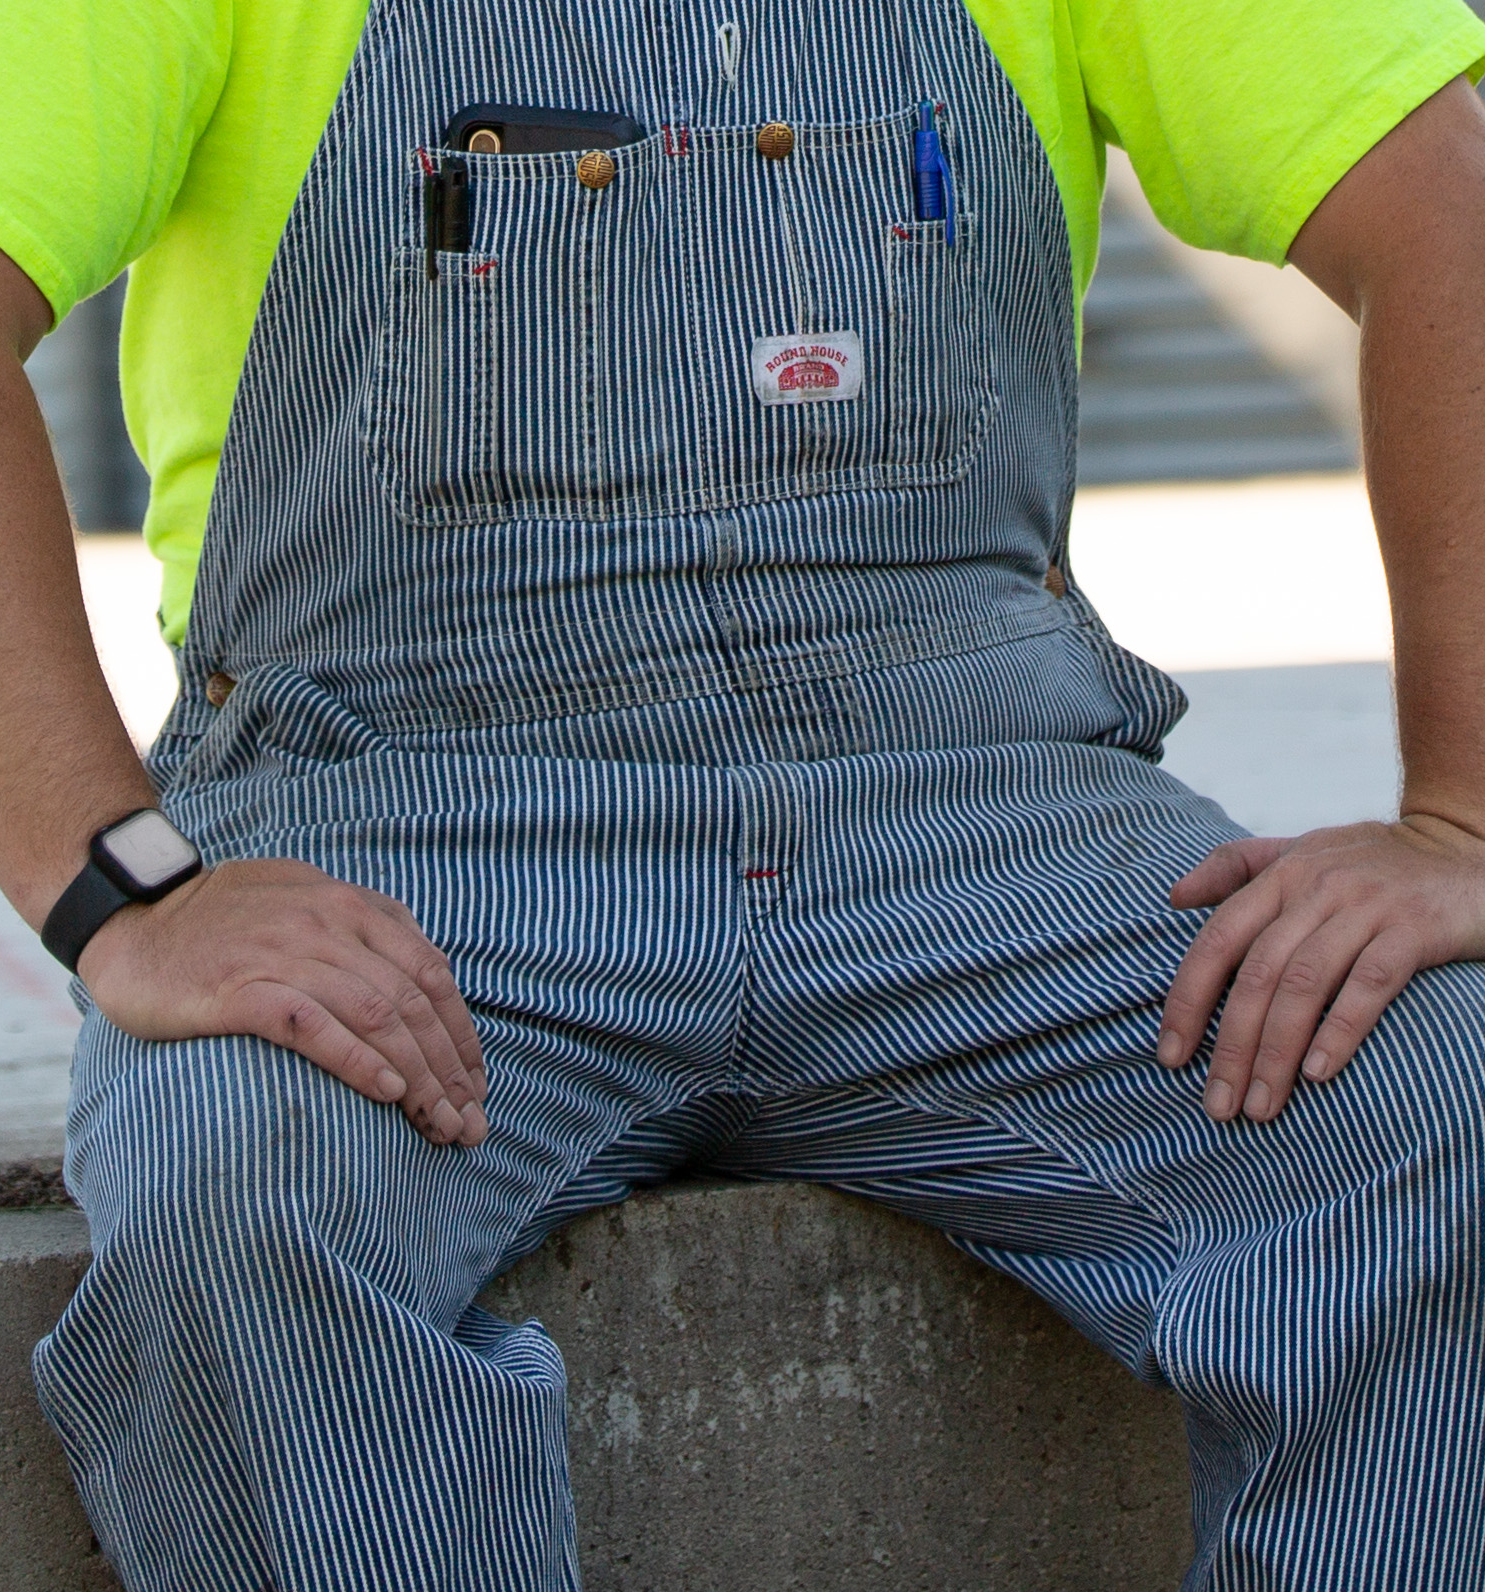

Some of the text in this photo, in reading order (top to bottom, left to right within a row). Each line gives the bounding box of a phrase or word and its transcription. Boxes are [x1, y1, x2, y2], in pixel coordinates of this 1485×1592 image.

[766, 346, 849, 373] ROUND HOUSE
[793, 363, 823, 373] BRAND
